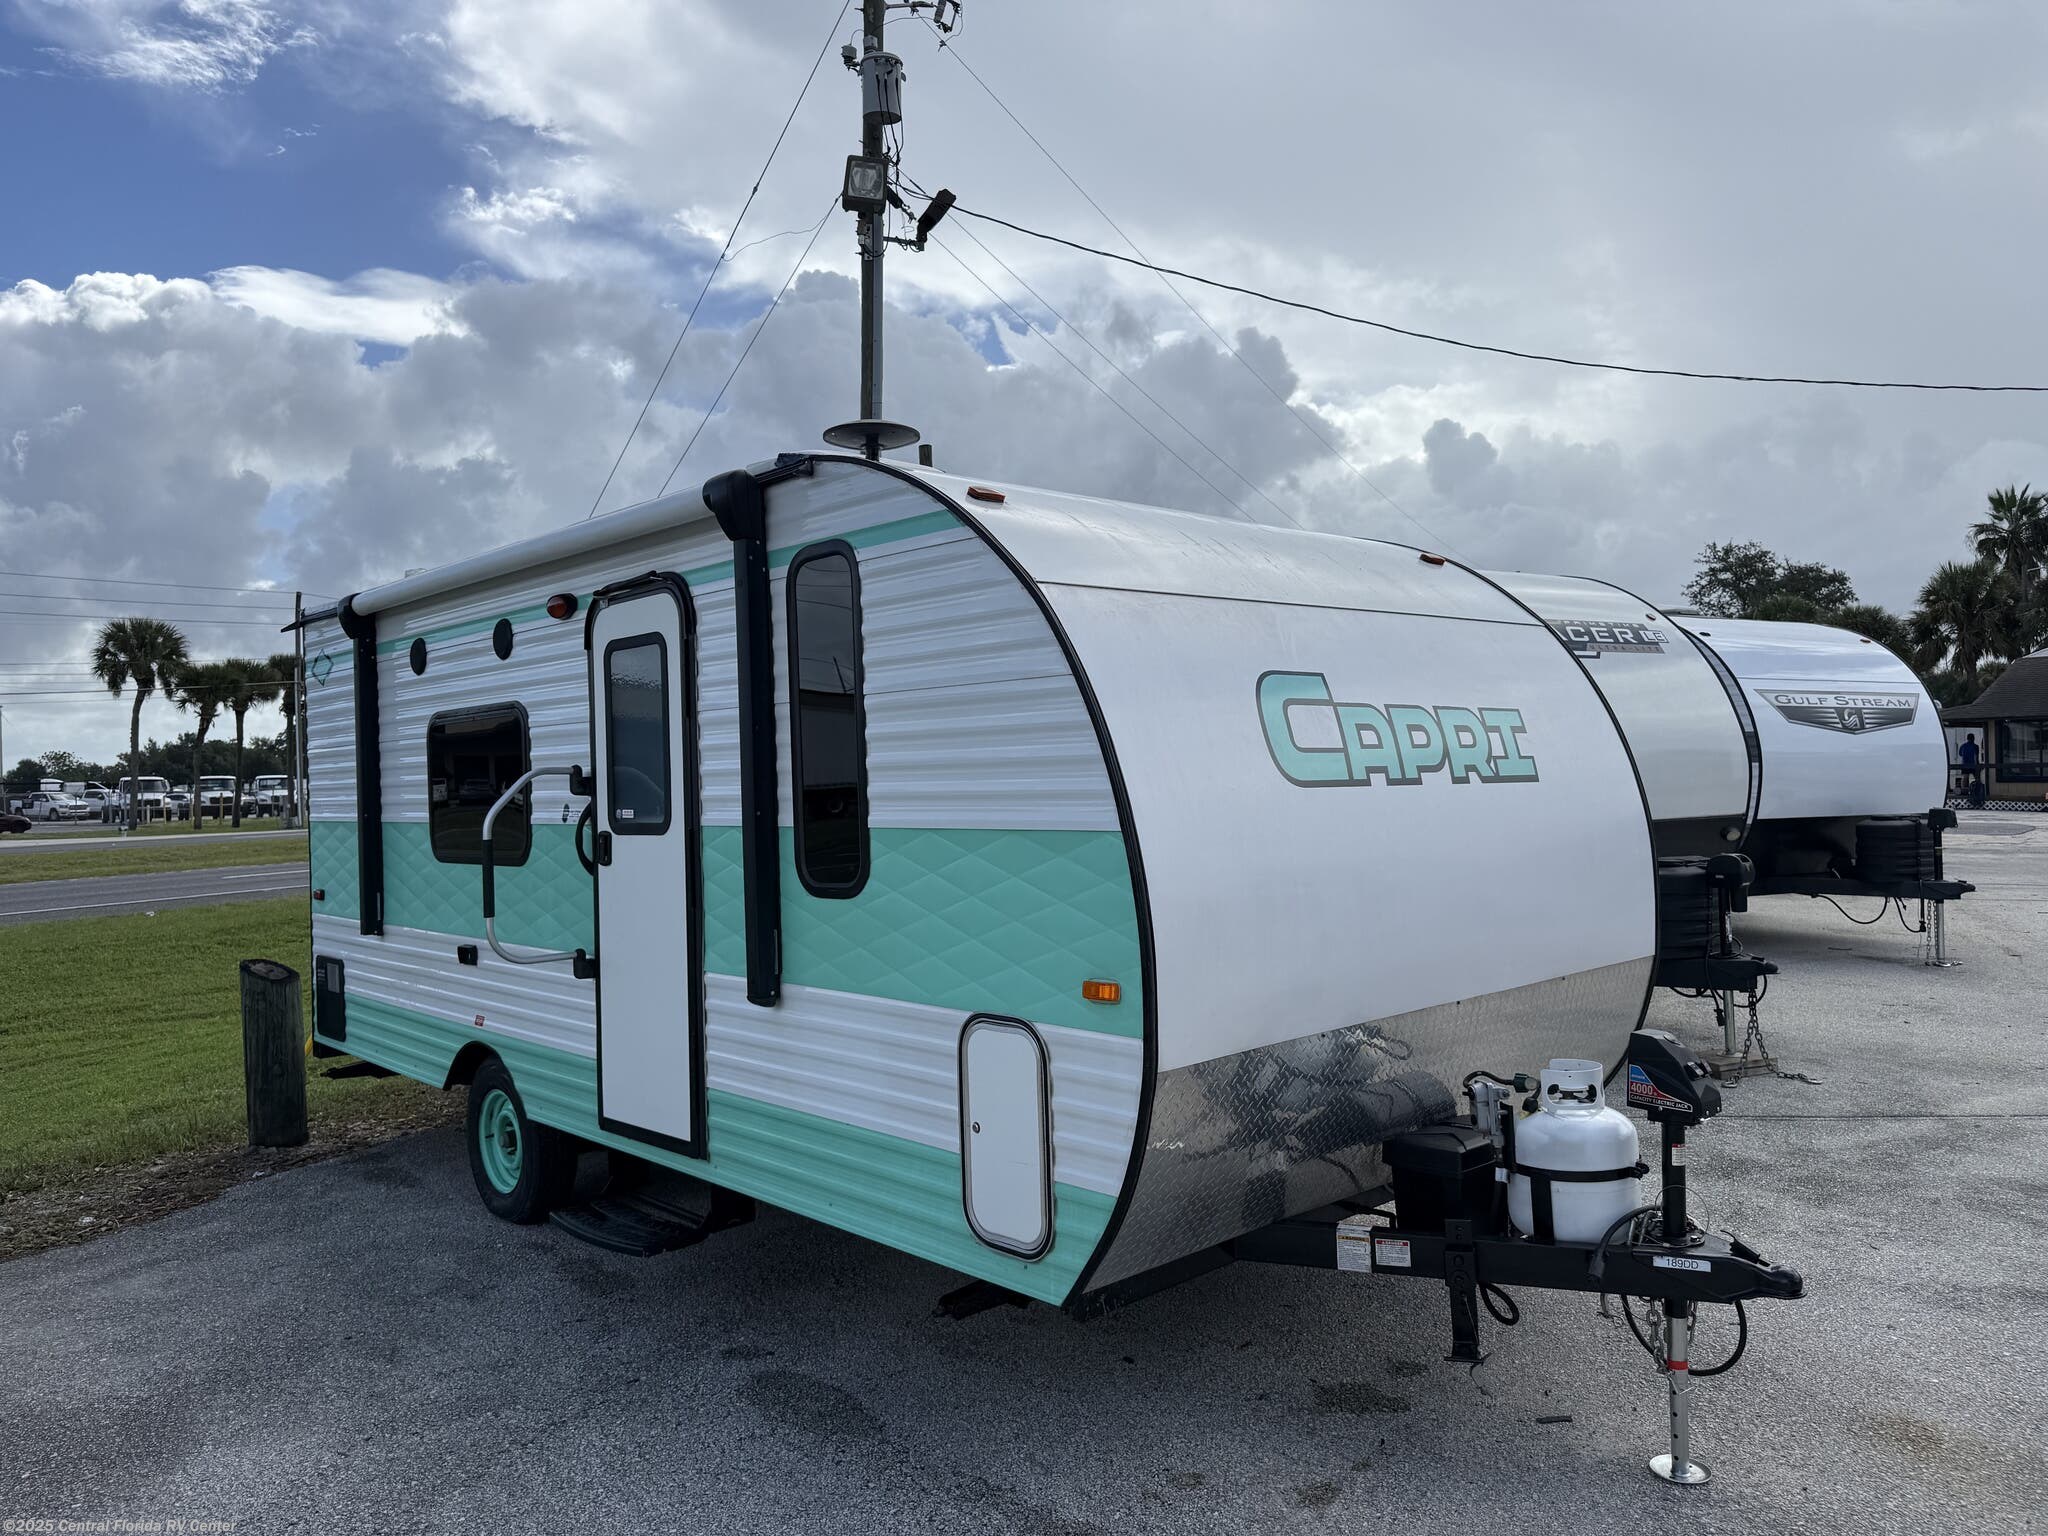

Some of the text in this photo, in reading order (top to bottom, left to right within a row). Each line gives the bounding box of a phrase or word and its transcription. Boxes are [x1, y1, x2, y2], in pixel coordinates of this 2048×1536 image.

[1774, 694, 1911, 707] GULF STREAM
[1255, 669, 1540, 788] CAPRI
[1631, 1082, 1653, 1095] 4000
[1631, 1095, 1652, 1103] CAPACITY
[1652, 1098, 1675, 1107] ELECTRIC
[1666, 1258, 1699, 1269] 189DD
